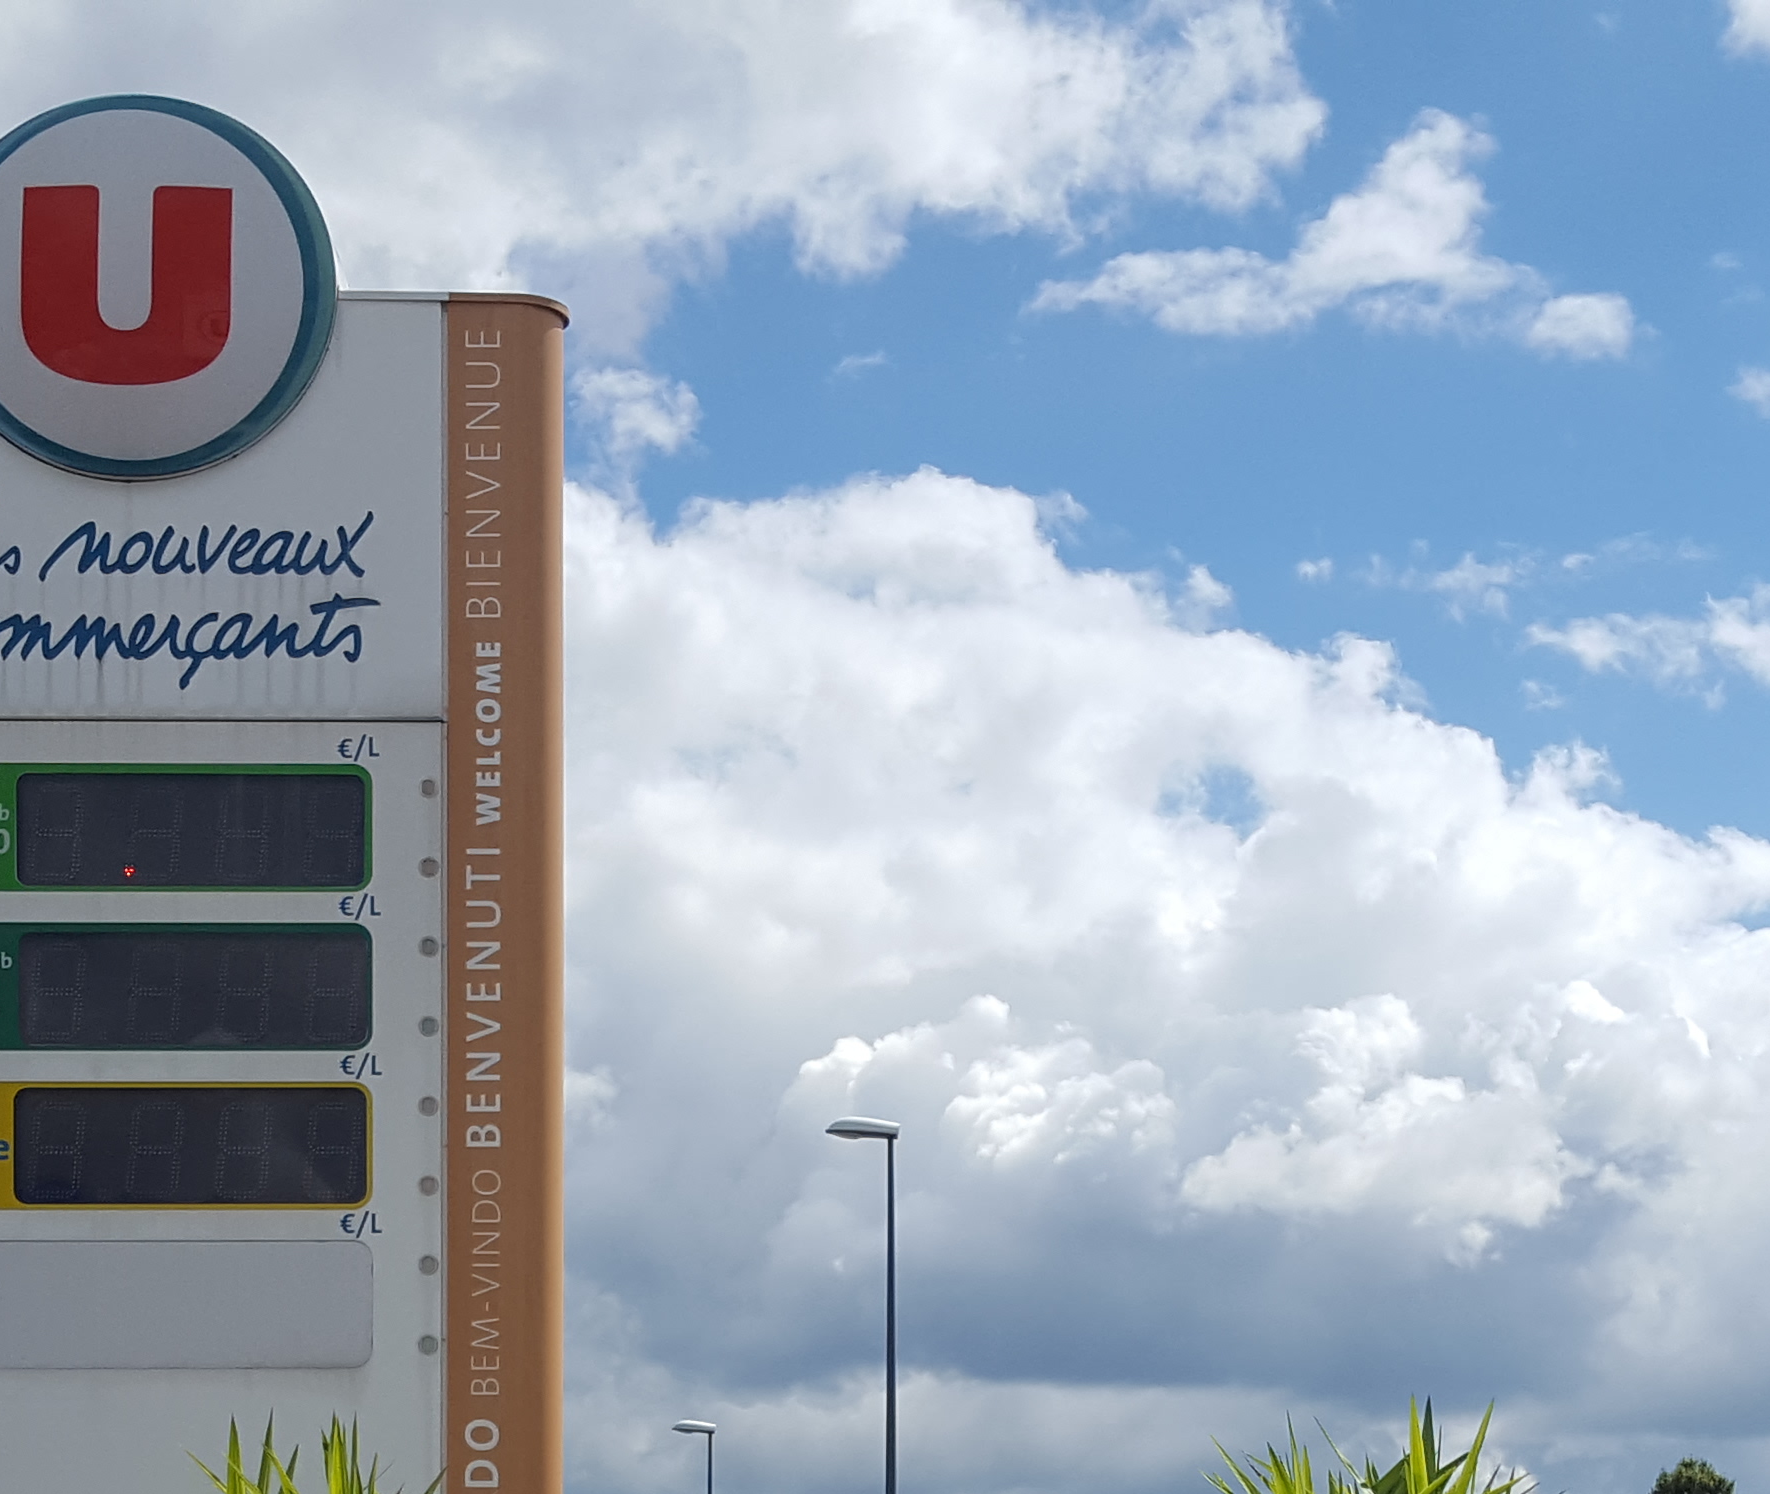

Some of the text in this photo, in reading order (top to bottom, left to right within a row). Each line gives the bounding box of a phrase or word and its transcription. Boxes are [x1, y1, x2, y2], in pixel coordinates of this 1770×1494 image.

[20, 184, 233, 386] U
[464, 328, 503, 620] BIENVENUE
[39, 510, 374, 583] nouveaux
[336, 736, 381, 760] €/L
[474, 640, 503, 826] WELCOME
[338, 895, 382, 919] €/L
[464, 846, 502, 1149] BENVENUTI
[339, 1054, 383, 1078] €/L
[339, 1213, 383, 1237] €/L
[470, 1168, 502, 1397] BEM-VINDO
